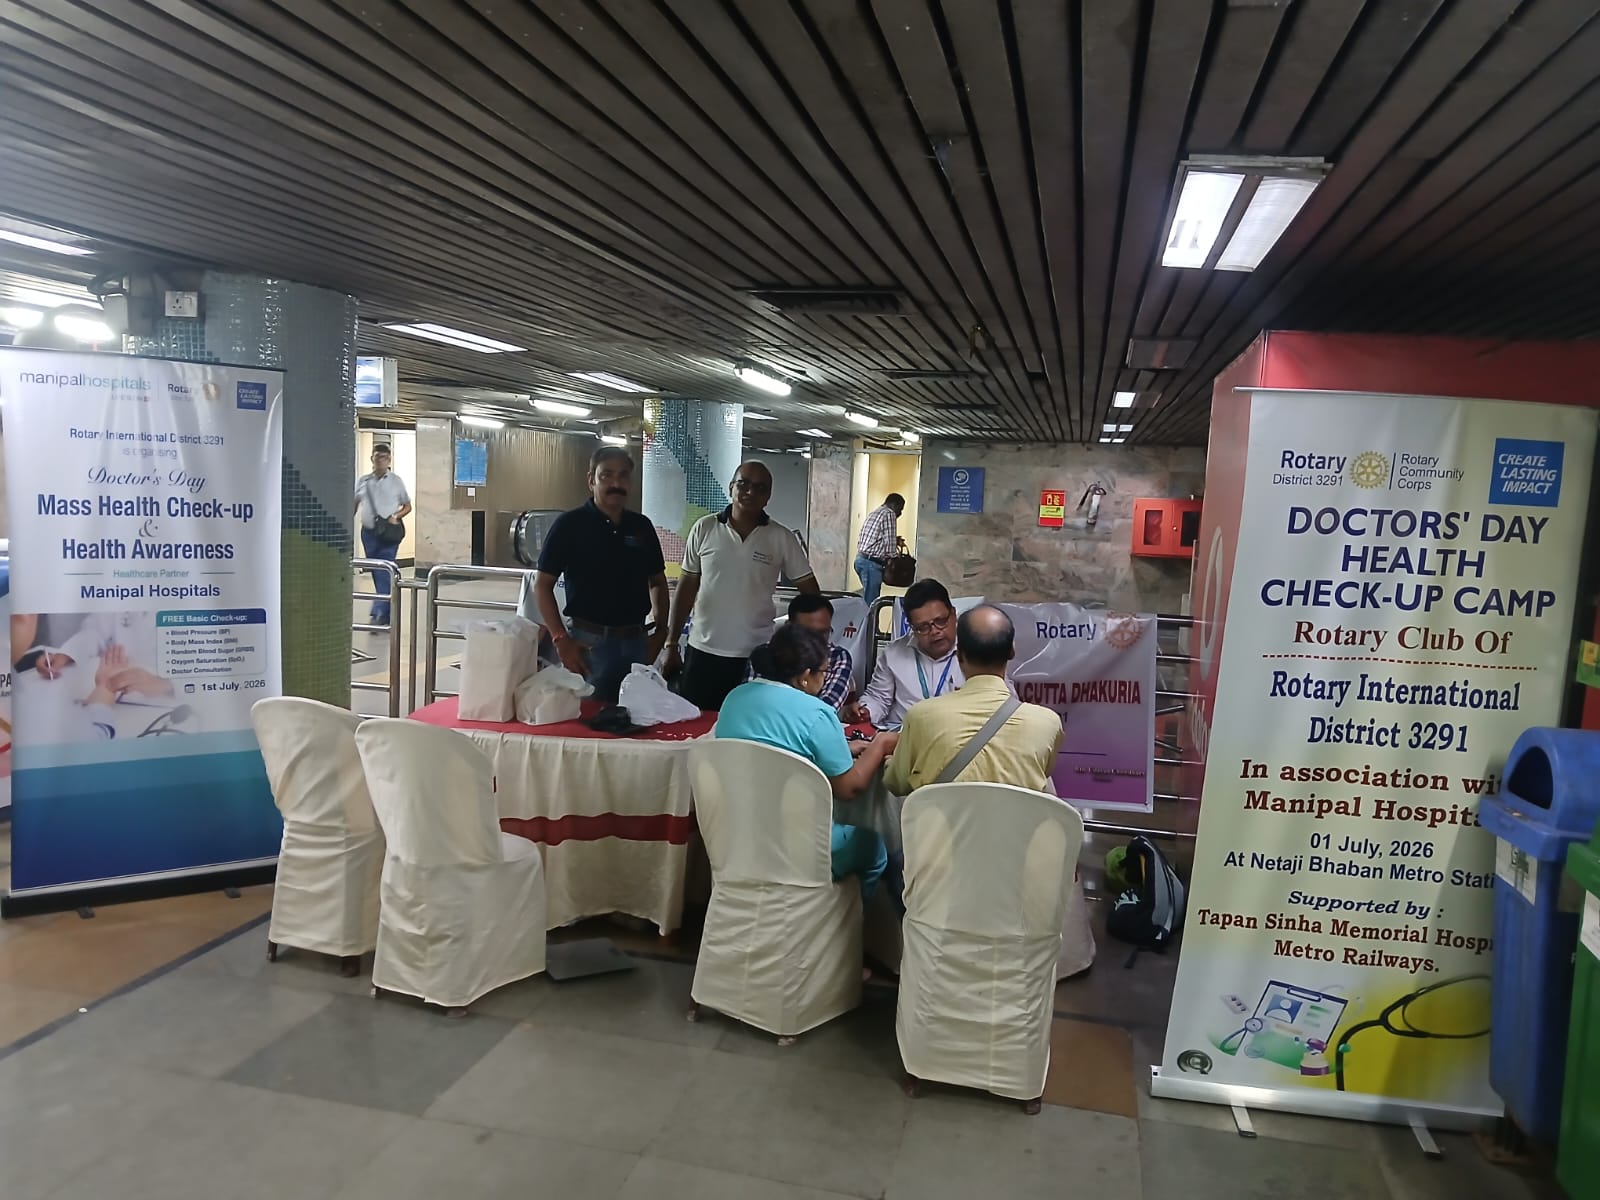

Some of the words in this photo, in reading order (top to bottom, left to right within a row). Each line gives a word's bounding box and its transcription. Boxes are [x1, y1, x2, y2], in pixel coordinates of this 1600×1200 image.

[20, 371, 151, 392] manipalhospitals
[170, 432, 202, 445] Dstrict
[1280, 450, 1347, 473] Rotary
[1400, 453, 1440, 468] Rotary
[1498, 453, 1547, 468] CREATE
[88, 466, 162, 486] Doctor's
[168, 470, 207, 494] Day
[1272, 473, 1313, 487] District
[1315, 475, 1344, 487] 3291
[1397, 478, 1432, 491] Corps
[1399, 466, 1465, 482] Community
[1500, 467, 1557, 482] LASTING
[1502, 480, 1553, 495] IMPACT
[37, 493, 92, 516] Mass
[98, 495, 161, 517] Health
[167, 496, 254, 523] Check-up
[138, 519, 159, 538] &
[1287, 506, 1470, 541] DOCTORS'
[1480, 513, 1550, 545] DAY
[62, 538, 126, 560] Health
[131, 539, 235, 560] Awareness
[1341, 544, 1486, 578] HEALTH
[113, 568, 158, 579] Healthcare
[160, 568, 190, 578] Partner
[80, 584, 144, 601] Manipal
[149, 583, 221, 600] Hospitals
[1260, 579, 1444, 613] CHECK-UP
[1453, 587, 1556, 618] CAMP
[162, 615, 185, 623] FREE
[186, 615, 209, 623] Basic
[1036, 621, 1097, 641] Rotary
[1292, 620, 1388, 653] Rotary
[1397, 625, 1464, 652] Club
[1474, 629, 1513, 655] Of
[201, 683, 217, 691] 1st
[244, 680, 266, 689] 2026
[1071, 680, 1141, 705] DHAKURIA
[1270, 670, 1352, 708] Rotary
[1356, 673, 1521, 711] International
[1307, 716, 1400, 748] District
[1408, 720, 1469, 753] 3291
[1239, 759, 1268, 779] In
[1279, 763, 1449, 791] association
[1462, 775, 1502, 796] wi
[1243, 790, 1362, 819] Manipal
[1310, 832, 1332, 850] 01
[1338, 835, 1383, 859] July,
[1389, 840, 1435, 859] 2026
[1224, 851, 1245, 868] At
[1250, 853, 1303, 874] Netaji
[1308, 856, 1384, 880] Bhaban
[1389, 862, 1444, 884] Metro
[1288, 890, 1398, 917] Supported
[1404, 899, 1431, 920] by
[1198, 909, 1258, 931] Tapan
[1264, 912, 1322, 934] Sinha
[1329, 918, 1428, 944] Memorial
[1274, 939, 1335, 964] Metro
[1342, 948, 1440, 973] Railways.
